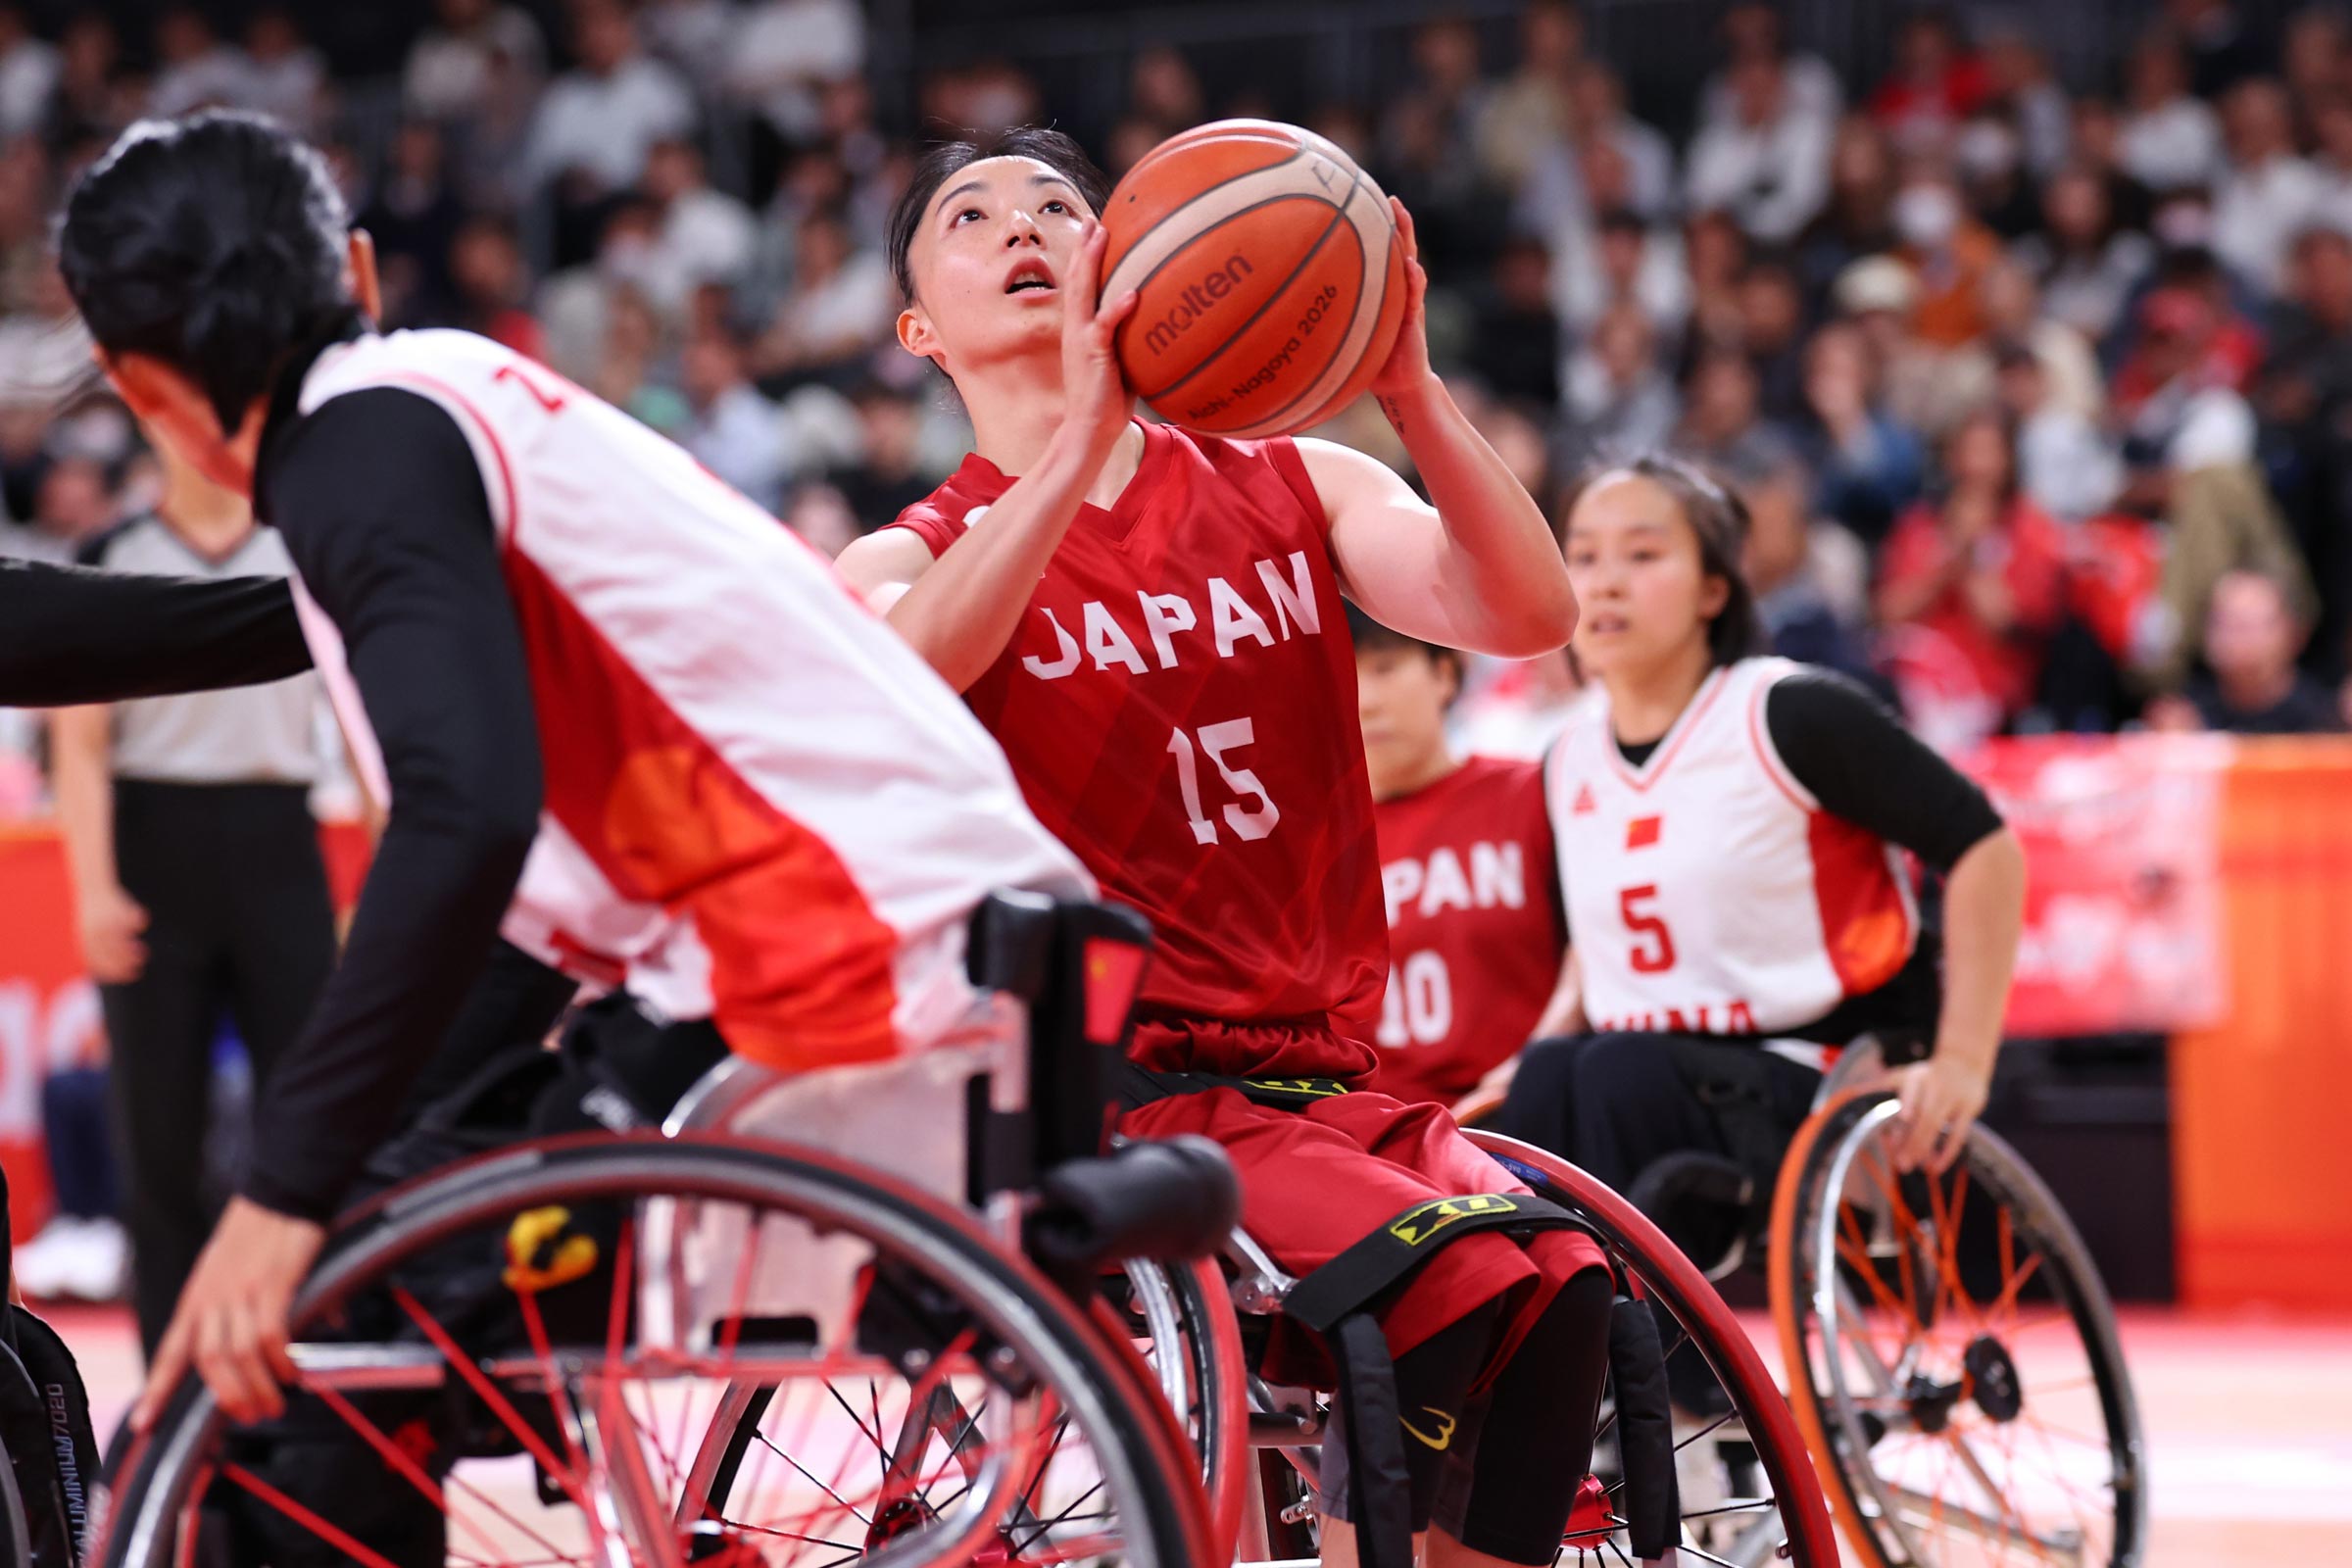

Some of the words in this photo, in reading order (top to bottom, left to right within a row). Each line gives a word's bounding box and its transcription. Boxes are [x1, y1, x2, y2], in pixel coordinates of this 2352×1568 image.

[1145, 253, 1253, 356] molten
[1188, 336, 1300, 420] Aichi-Nagoya
[1298, 285, 1337, 334] 2026
[1021, 550, 1321, 680] JAPAN
[1166, 716, 1280, 845] 15
[1380, 844, 1526, 928] PAN
[1620, 884, 1675, 972] 5
[1376, 948, 1452, 1040] 10
